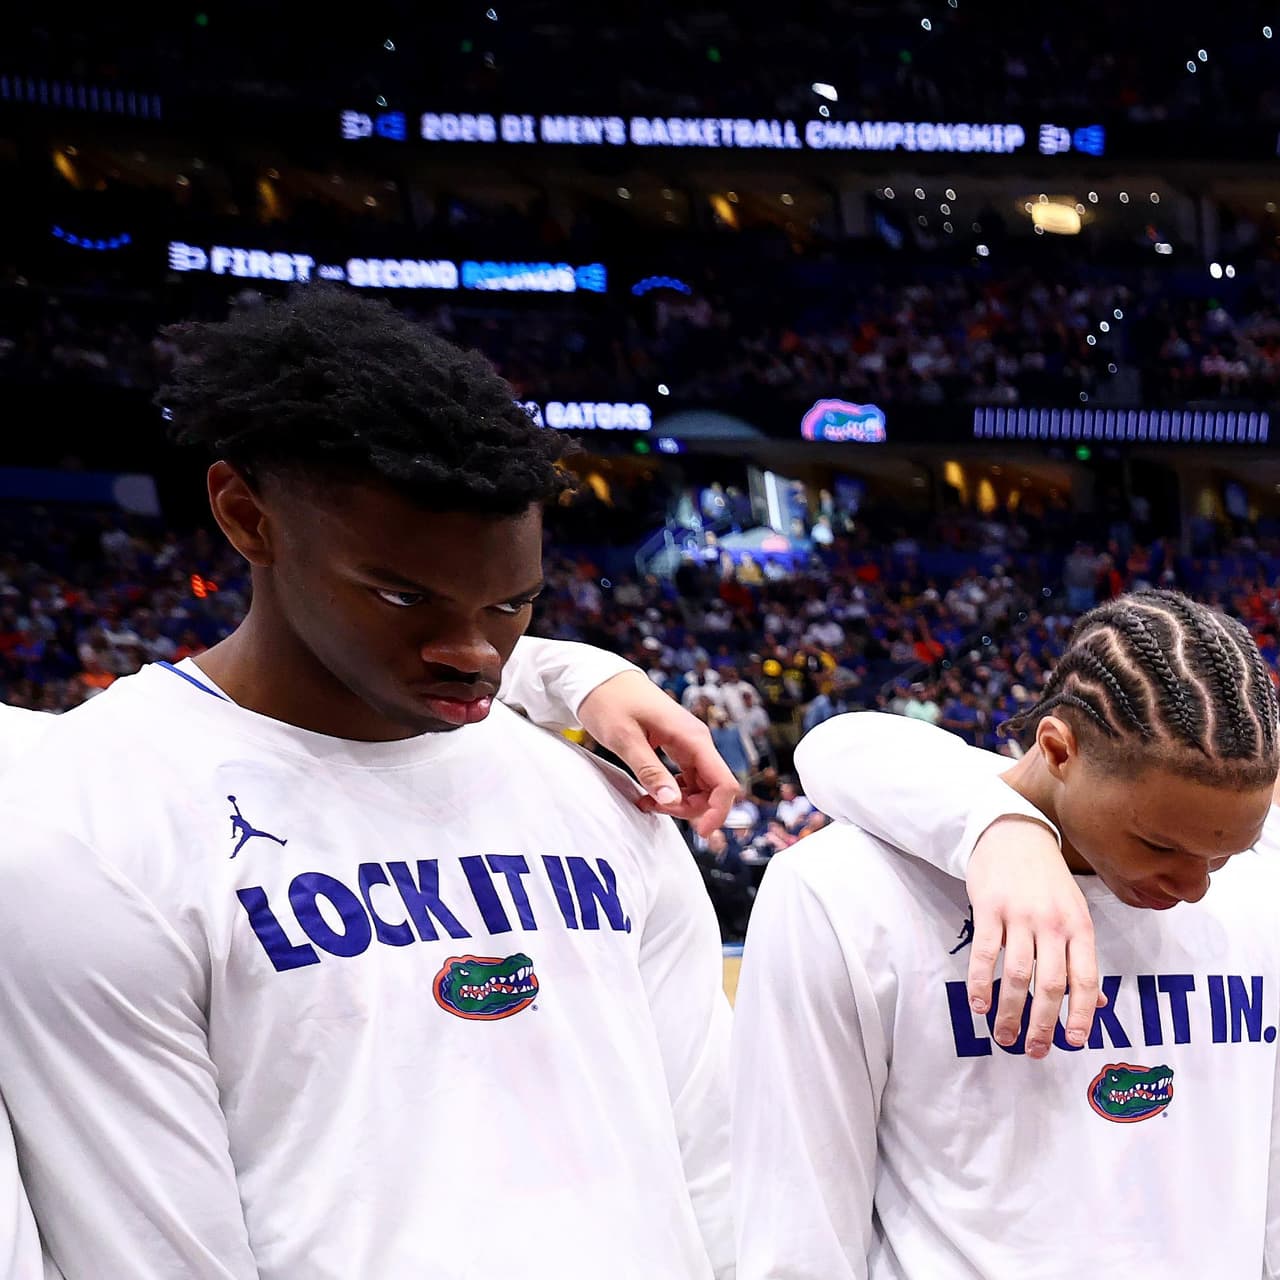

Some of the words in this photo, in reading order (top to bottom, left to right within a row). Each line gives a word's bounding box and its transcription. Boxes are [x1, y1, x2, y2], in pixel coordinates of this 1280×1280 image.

[630, 117, 802, 149] BASKETBALL
[805, 120, 1025, 153] CHAMPIONSHIP
[211, 246, 315, 283] FIRST
[346, 258, 459, 289] SECOND
[546, 402, 651, 430] GATORS
[236, 859, 472, 972] LOCK
[460, 854, 538, 935] IT
[541, 855, 632, 935] IN.
[1138, 974, 1195, 1048] IT
[1208, 975, 1277, 1044] IN.
